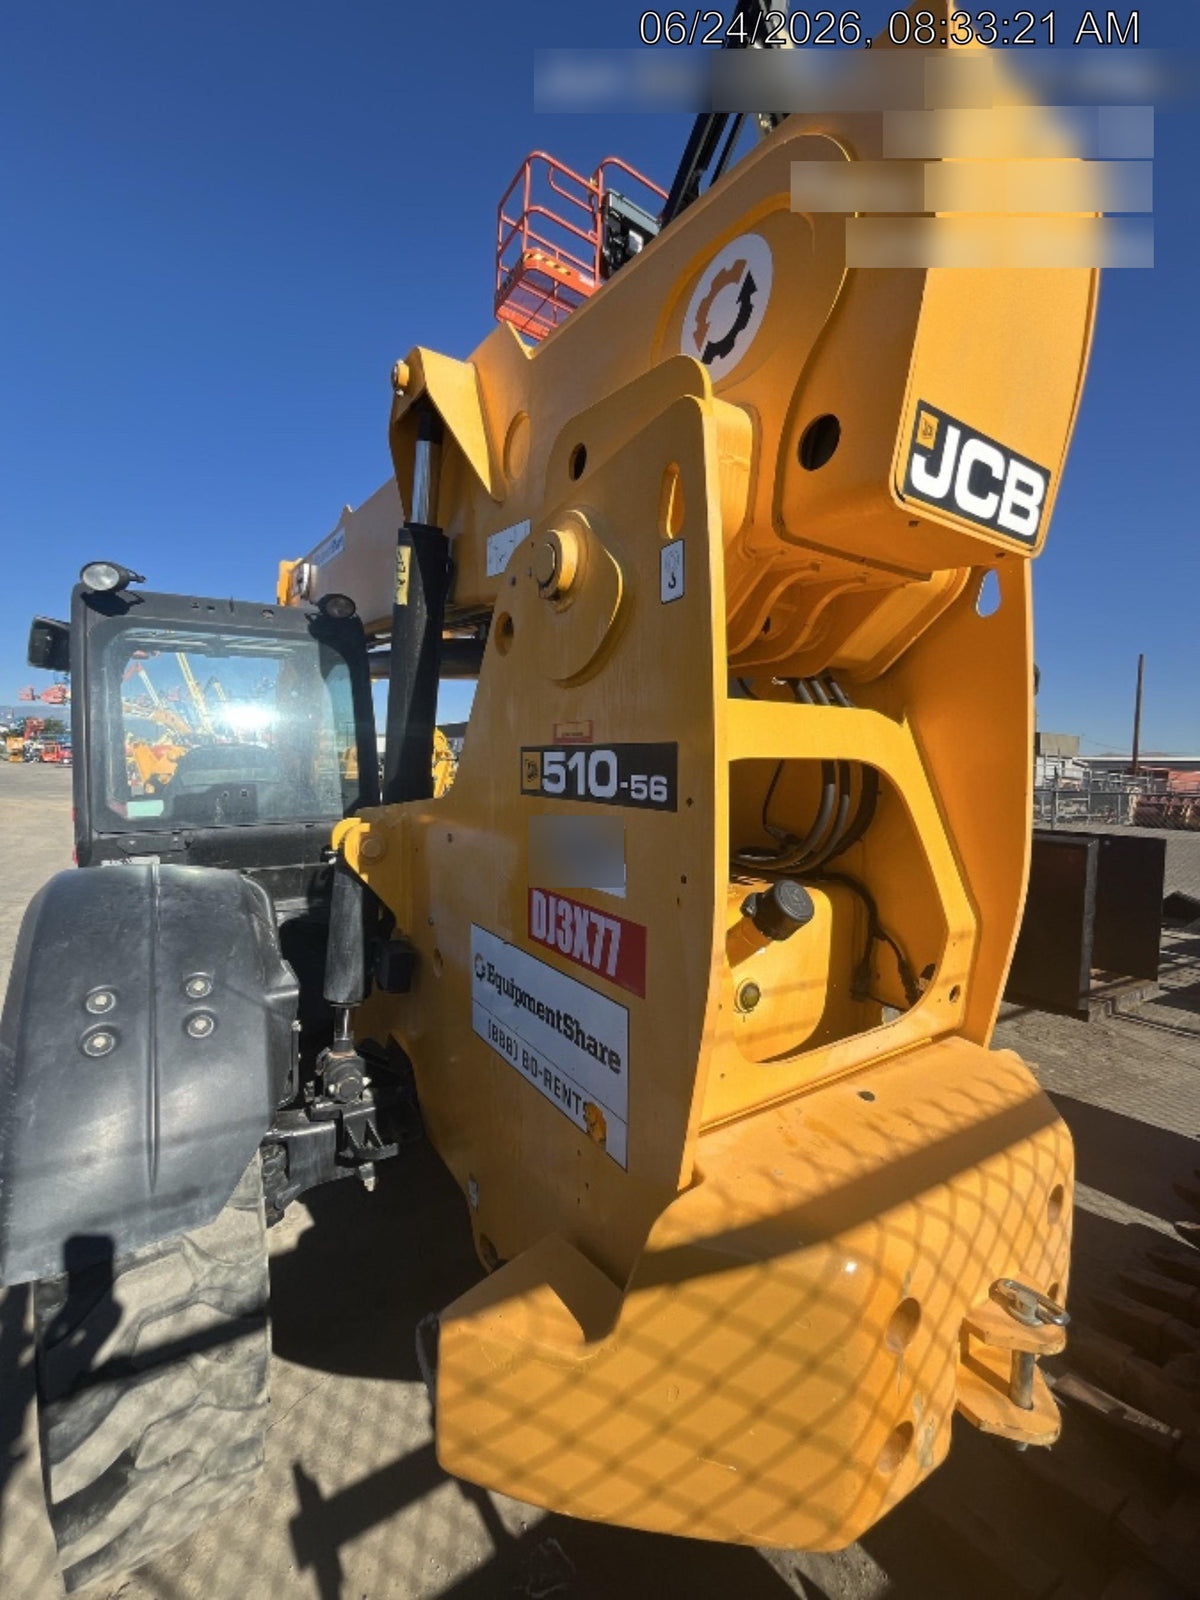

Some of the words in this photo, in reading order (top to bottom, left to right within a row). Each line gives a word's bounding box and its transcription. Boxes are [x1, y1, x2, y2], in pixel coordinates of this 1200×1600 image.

[910, 425, 1045, 536] JCB
[486, 961, 622, 1075] EquipmentShare
[488, 1019, 518, 1062] (888)
